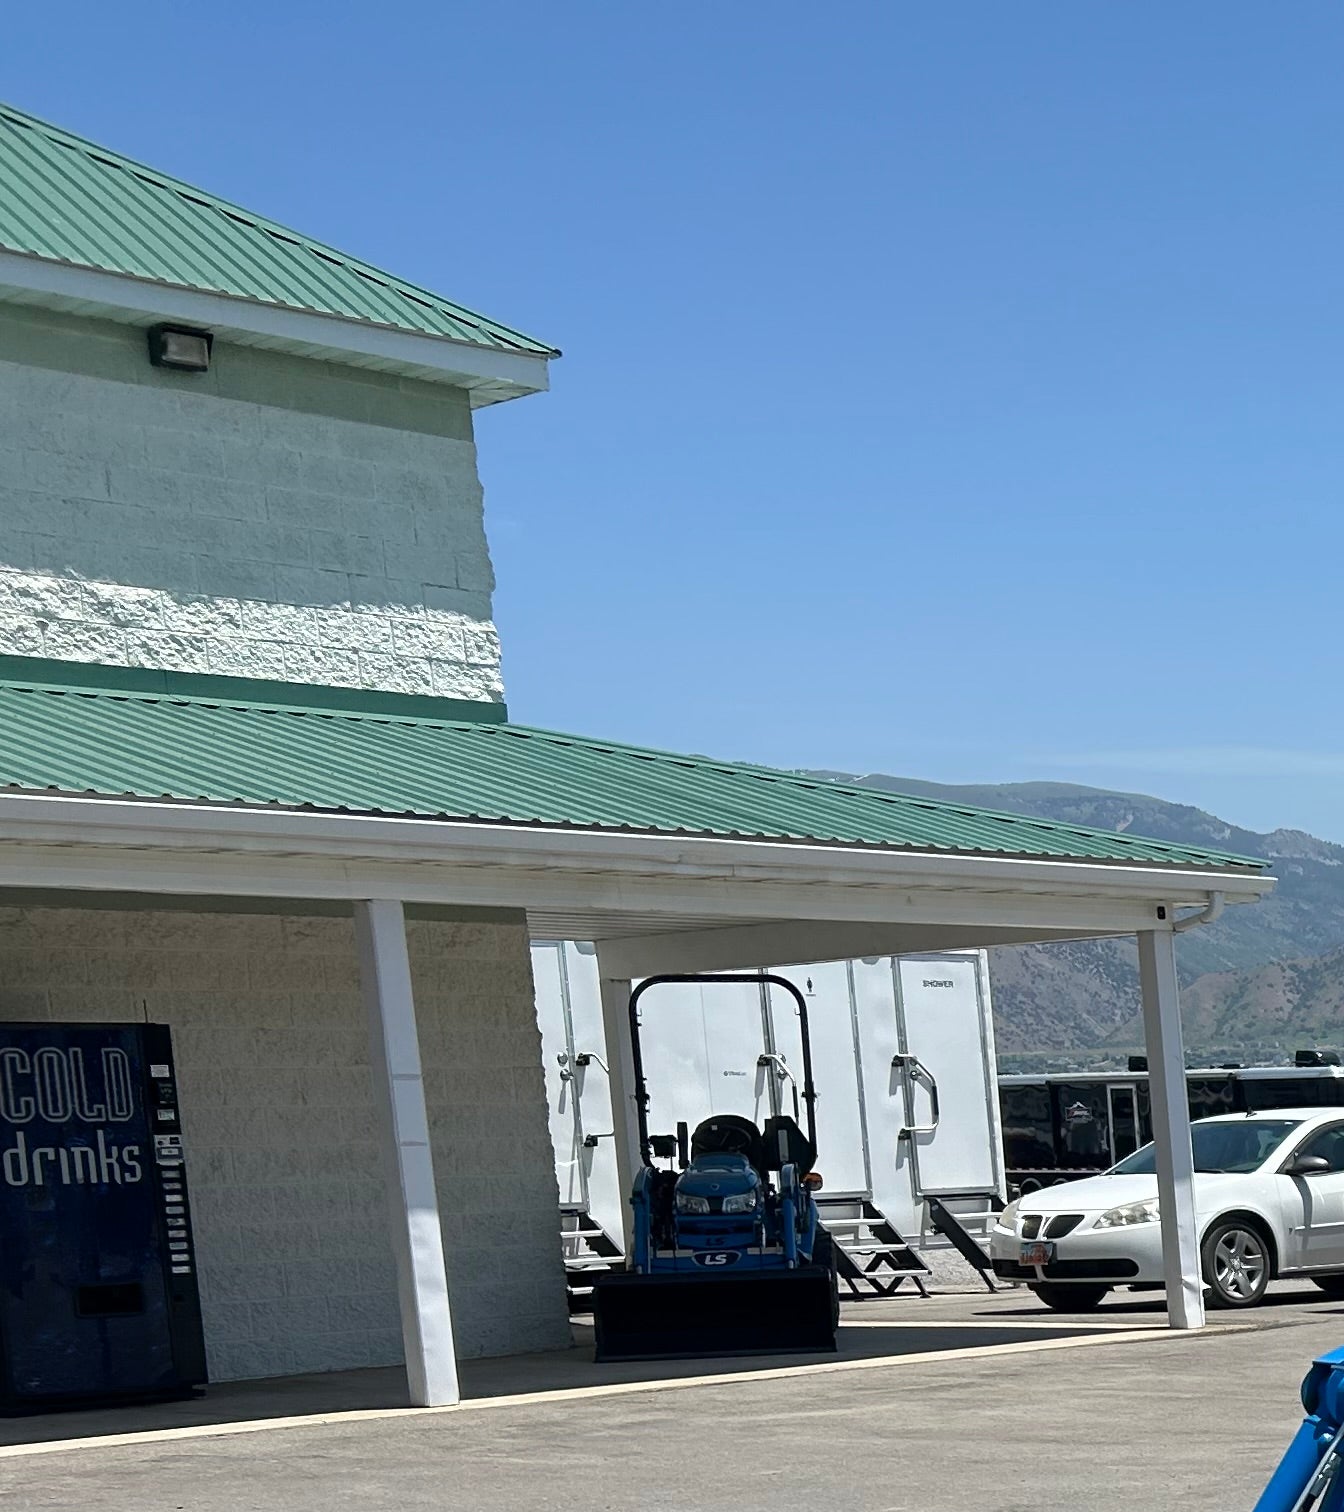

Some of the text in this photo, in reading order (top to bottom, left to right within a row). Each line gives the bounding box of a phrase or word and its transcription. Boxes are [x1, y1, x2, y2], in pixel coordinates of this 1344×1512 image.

[0, 1047, 134, 1123] COLD
[3, 1129, 142, 1186] drinks
[704, 1254, 728, 1265] LS
